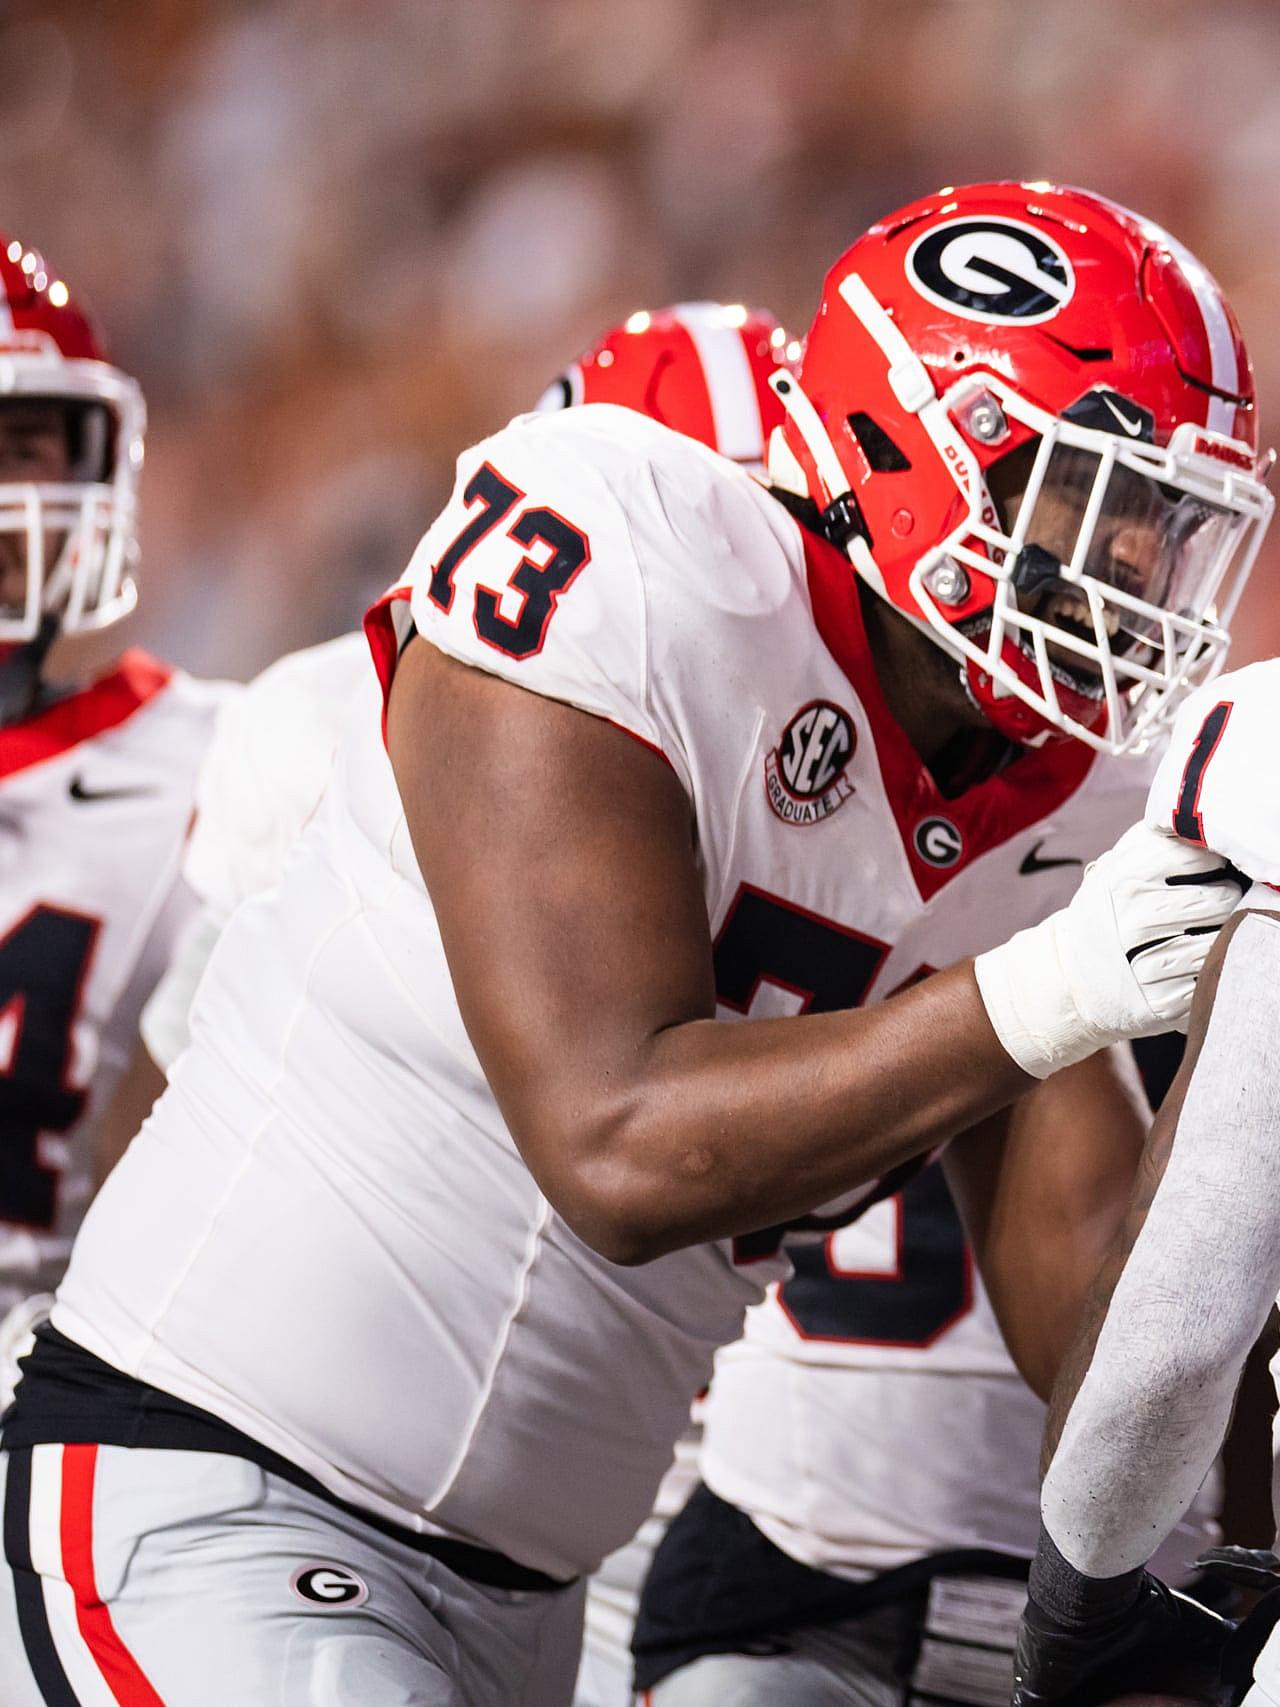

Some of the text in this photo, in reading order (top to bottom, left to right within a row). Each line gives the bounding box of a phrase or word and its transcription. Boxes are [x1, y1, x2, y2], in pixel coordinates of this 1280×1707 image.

[913, 222, 1067, 317] G
[427, 459, 592, 662] 73
[782, 706, 850, 793] SEC
[1172, 701, 1234, 847] 1
[768, 774, 834, 822] GRADUATE
[916, 819, 962, 866] G
[296, 1567, 360, 1603] G
